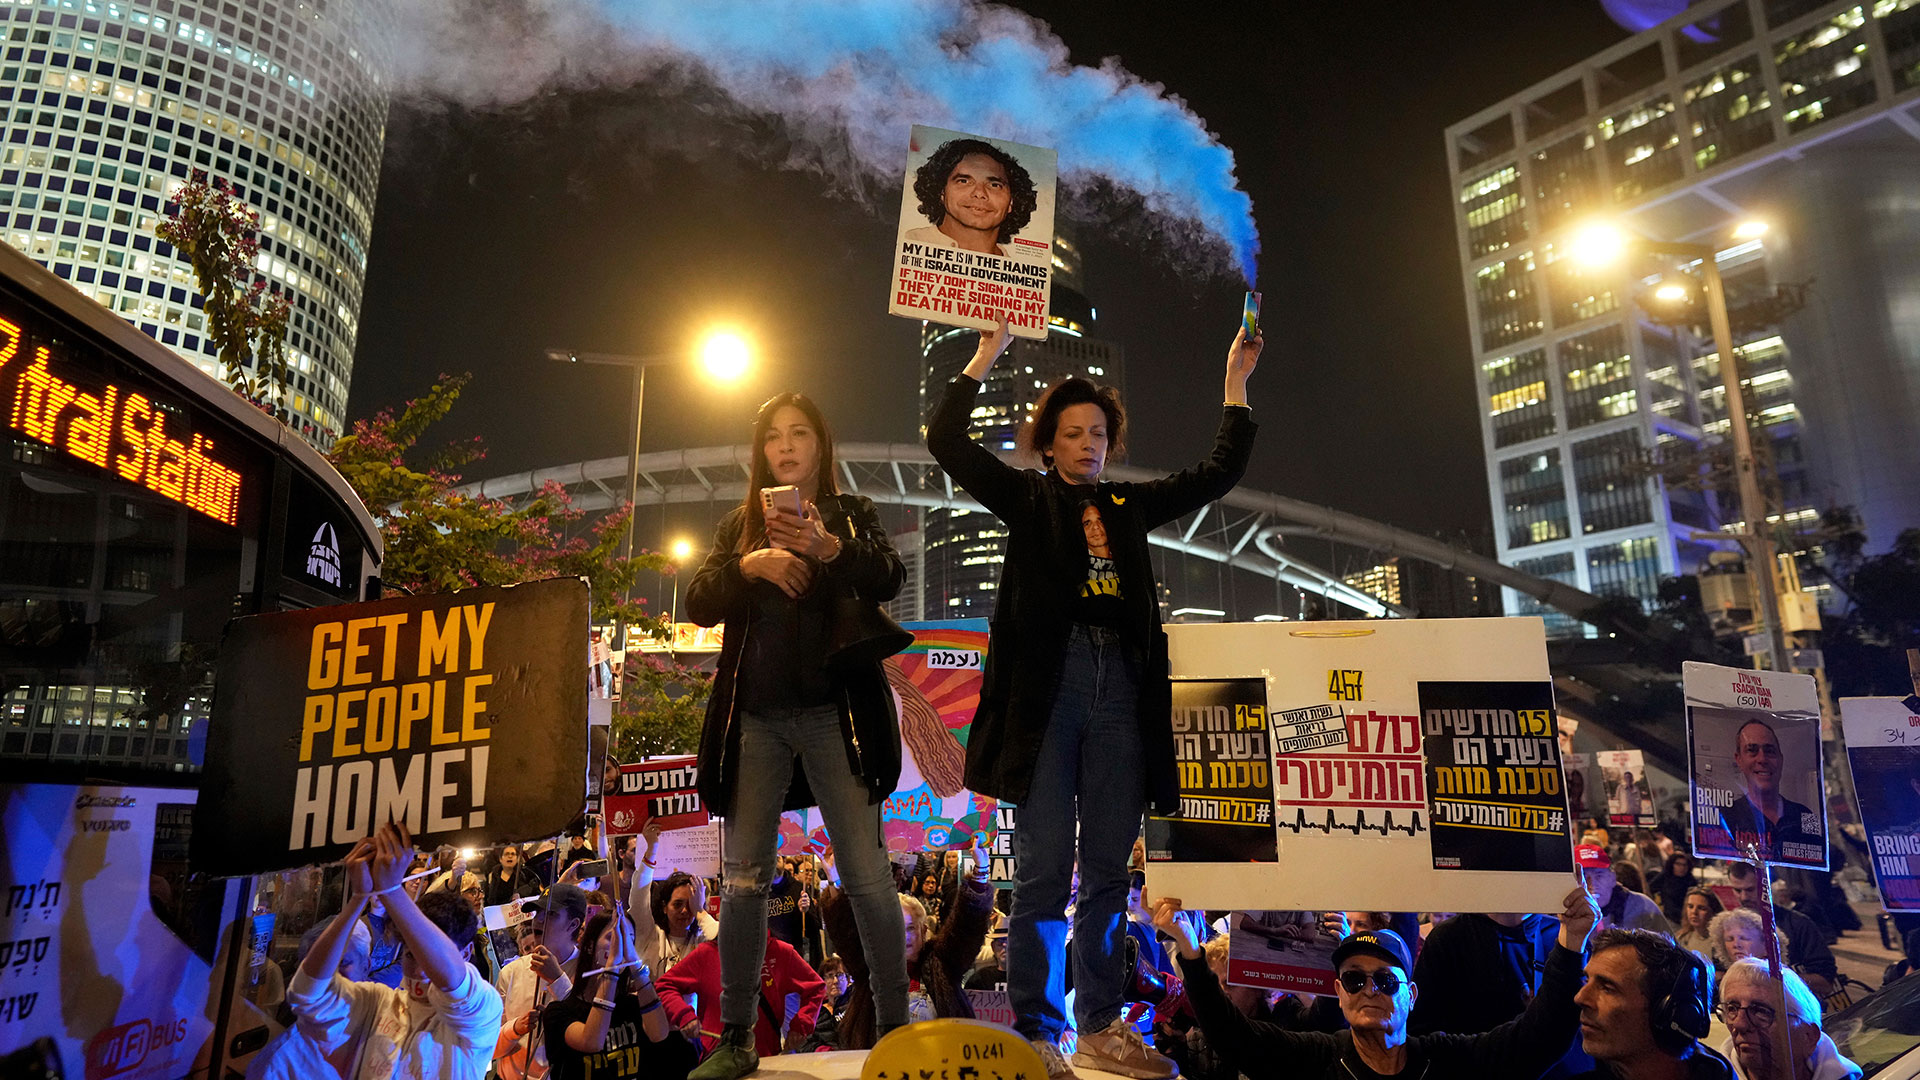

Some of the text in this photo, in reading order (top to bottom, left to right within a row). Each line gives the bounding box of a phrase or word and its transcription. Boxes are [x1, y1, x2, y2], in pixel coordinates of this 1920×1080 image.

[901, 255, 1047, 290] OF THE ISRAELI GOVERNMENT
[902, 242, 1047, 278] MY LIFE IS IN THE HANDS
[899, 279, 1045, 315] THEY ARE SIGNING MY
[900, 268, 1046, 303] IF THEY DON'T SIGN A DEAL
[896, 291, 952, 314] DEATH
[116, 393, 242, 527] Station
[307, 602, 496, 690] GET MY
[931, 651, 980, 668] נעמה
[1732, 682, 1772, 698] TSACHI IDAN
[1736, 695, 1757, 708] (50)
[298, 674, 493, 762] PEOPLE
[1171, 705, 1231, 732] חודש
[1237, 704, 1262, 731] 15
[1282, 706, 1333, 724] נשות ואנשי
[1295, 721, 1327, 736] בריאות
[1425, 709, 1518, 736] חודשים
[1518, 710, 1549, 736] 15
[1282, 731, 1344, 751] למען החטופים
[1346, 710, 1421, 754] כולם
[1884, 727, 1905, 744] 34
[1207, 733, 1267, 760] בשבי
[1453, 738, 1557, 766] בשבי הם
[621, 764, 698, 793] לחופש
[1210, 761, 1269, 789] סכנת
[1276, 760, 1423, 801] הומניטרי
[1434, 767, 1560, 795] סכנת מוות
[289, 745, 490, 851] HOME!
[655, 793, 700, 817] נולדו
[1180, 798, 1271, 823] #כולםהומנ
[1695, 786, 1734, 808] BRING
[1434, 801, 1564, 831] #כולםהומניטרי
[1697, 805, 1720, 826] HIM
[1782, 847, 1805, 858] FAMILIES
[1805, 850, 1823, 860] FORUM
[1873, 835, 1920, 855] BRING
[1878, 856, 1910, 876] HIM
[1242, 969, 1324, 986] אל תתנו לו להשאר בשבי
[150, 1018, 188, 1051] BUS
[963, 1043, 1004, 1060] 01241
